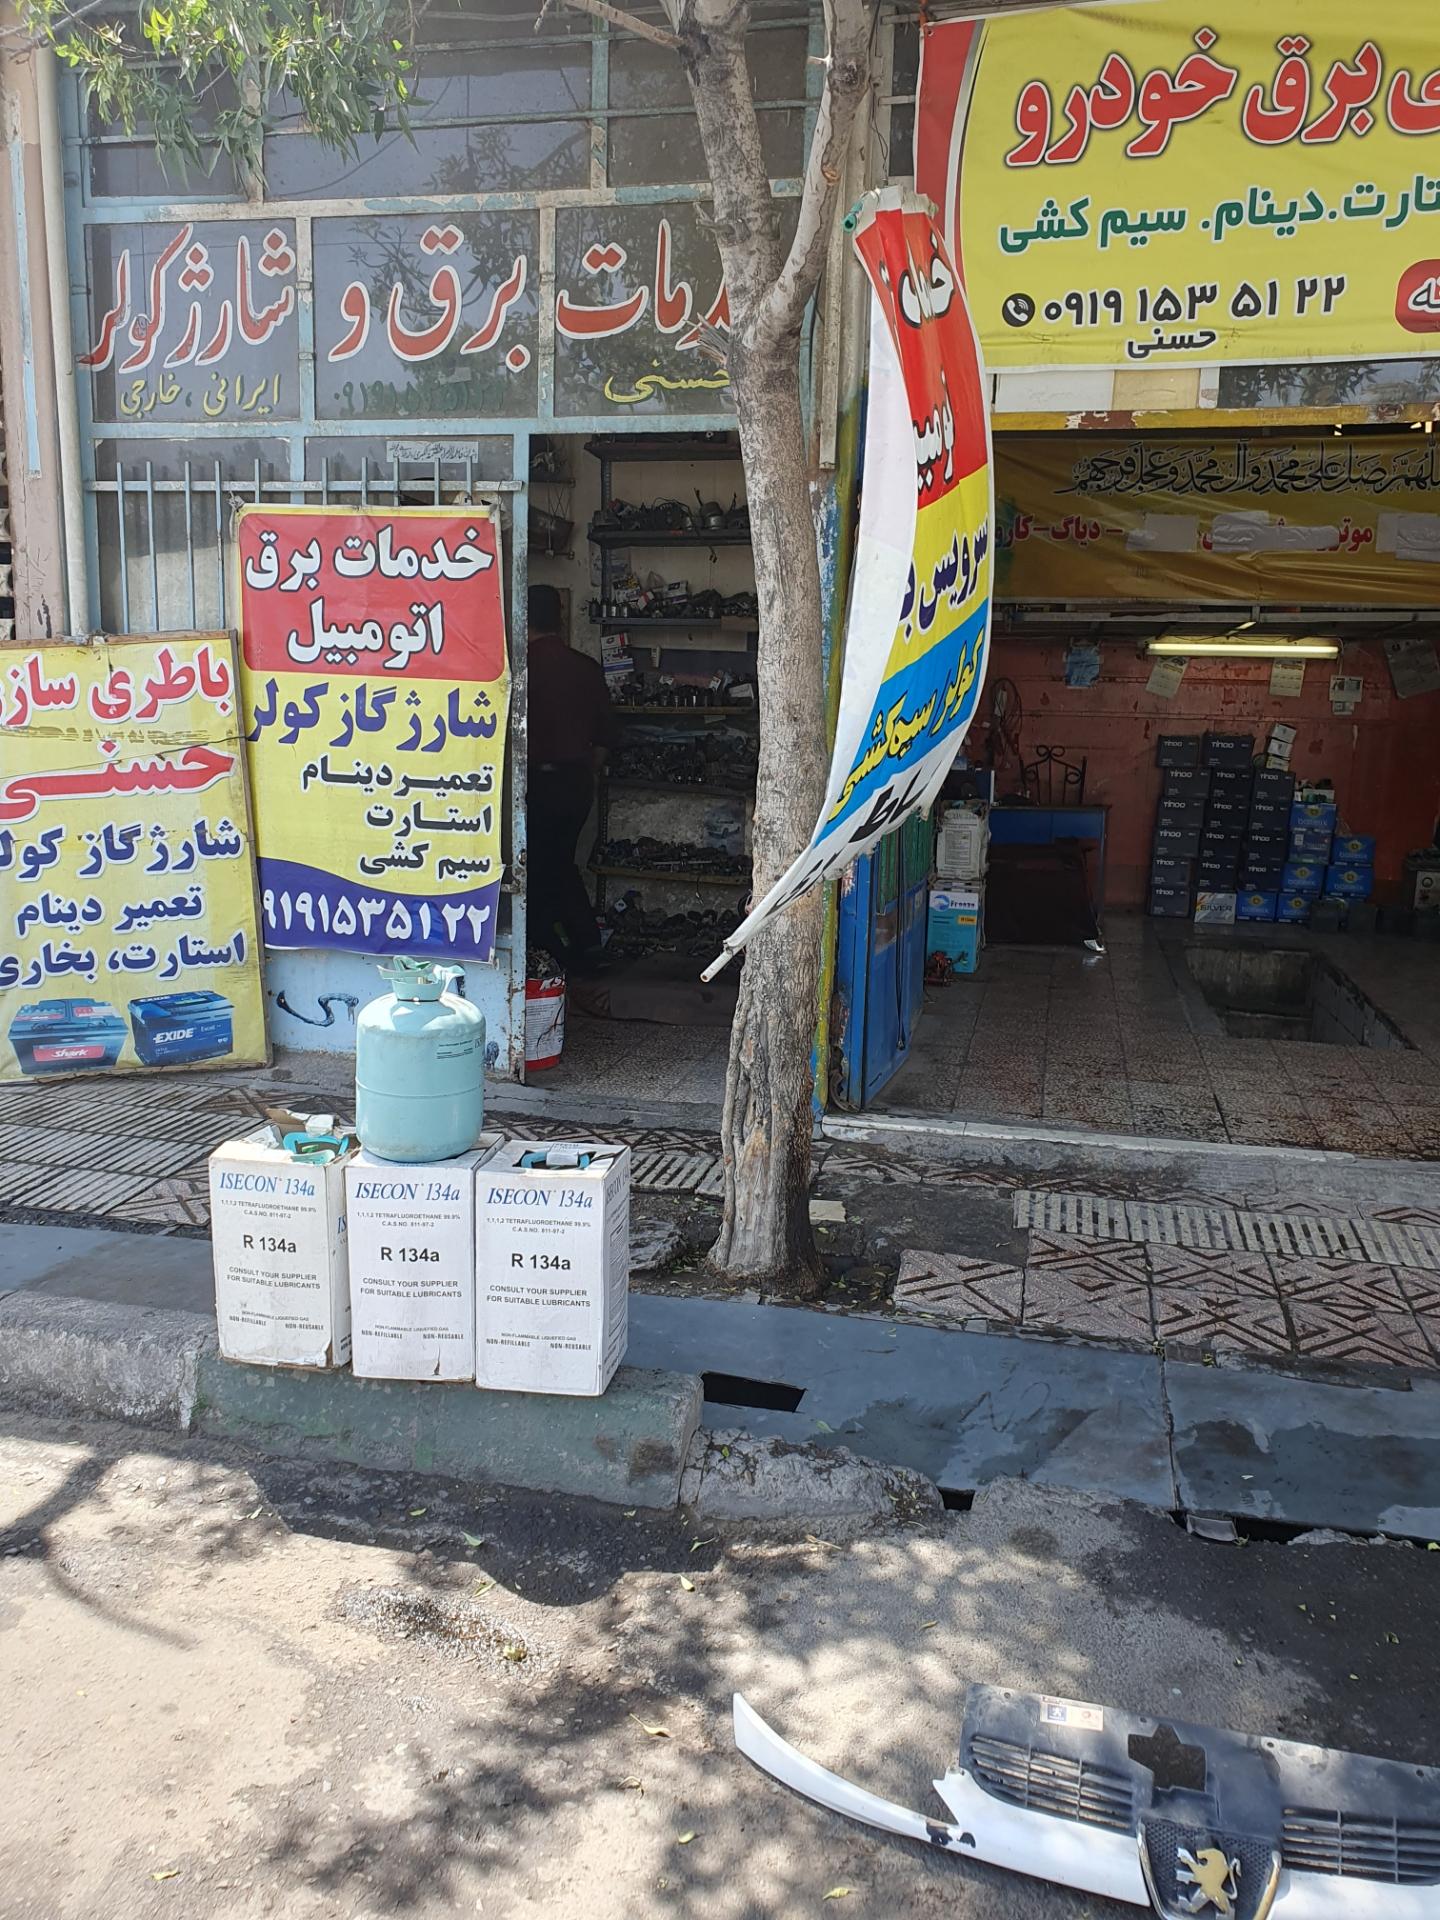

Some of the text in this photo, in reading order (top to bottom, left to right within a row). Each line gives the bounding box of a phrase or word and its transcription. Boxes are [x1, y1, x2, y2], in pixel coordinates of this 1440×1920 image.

[1005, 27, 1239, 167] خودرو
[1243, 34, 1382, 145] برق
[1000, 198, 1091, 253] کشی
[1099, 207, 1187, 248] سیم
[79, 224, 193, 372] کولر
[164, 228, 296, 368] شارژ
[387, 225, 528, 372] برق
[1043, 289, 1122, 326] ۰۹۱۹
[1138, 283, 1218, 323] ۱۵۳
[1296, 276, 1346, 313] ۲۲
[329, 281, 370, 362] و
[1127, 327, 1217, 359] حسنی
[121, 373, 182, 415] خارجی
[245, 525, 495, 593] خدمات برق
[287, 597, 444, 670] اتومبیل
[0, 645, 235, 728] باطری ساز
[247, 677, 498, 754] شارژ گاز کولر
[301, 753, 494, 799] تعمیر دینام
[366, 800, 492, 839] استارت
[0, 818, 242, 881] شارژ گاز کول
[359, 840, 491, 883] سیم کشی
[16, 885, 204, 940] تعمیر دینام
[153, 1027, 195, 1045] EXIDE
[220, 1172, 315, 1197] ISECON 134a
[355, 1182, 461, 1201] ISECON 134a
[486, 1187, 593, 1209] ISECON 134a
[243, 1234, 297, 1254] R 134a
[380, 1247, 440, 1263] R 134a
[511, 1253, 571, 1271] R 134a
[227, 1275, 321, 1290] FOR SUITABLE LUBRICANTS
[229, 1266, 317, 1281] CONSULT YOUR SUPPLIER
[360, 1287, 462, 1299] FOR SUITABLE LUBRICANTS
[363, 1278, 458, 1288] CONSULT YOUR SUPPLIER
[489, 1285, 587, 1297] CONSULT YOUR SUPPLIER
[486, 1295, 591, 1308] FOR SUITABLE LUBRICANTS
